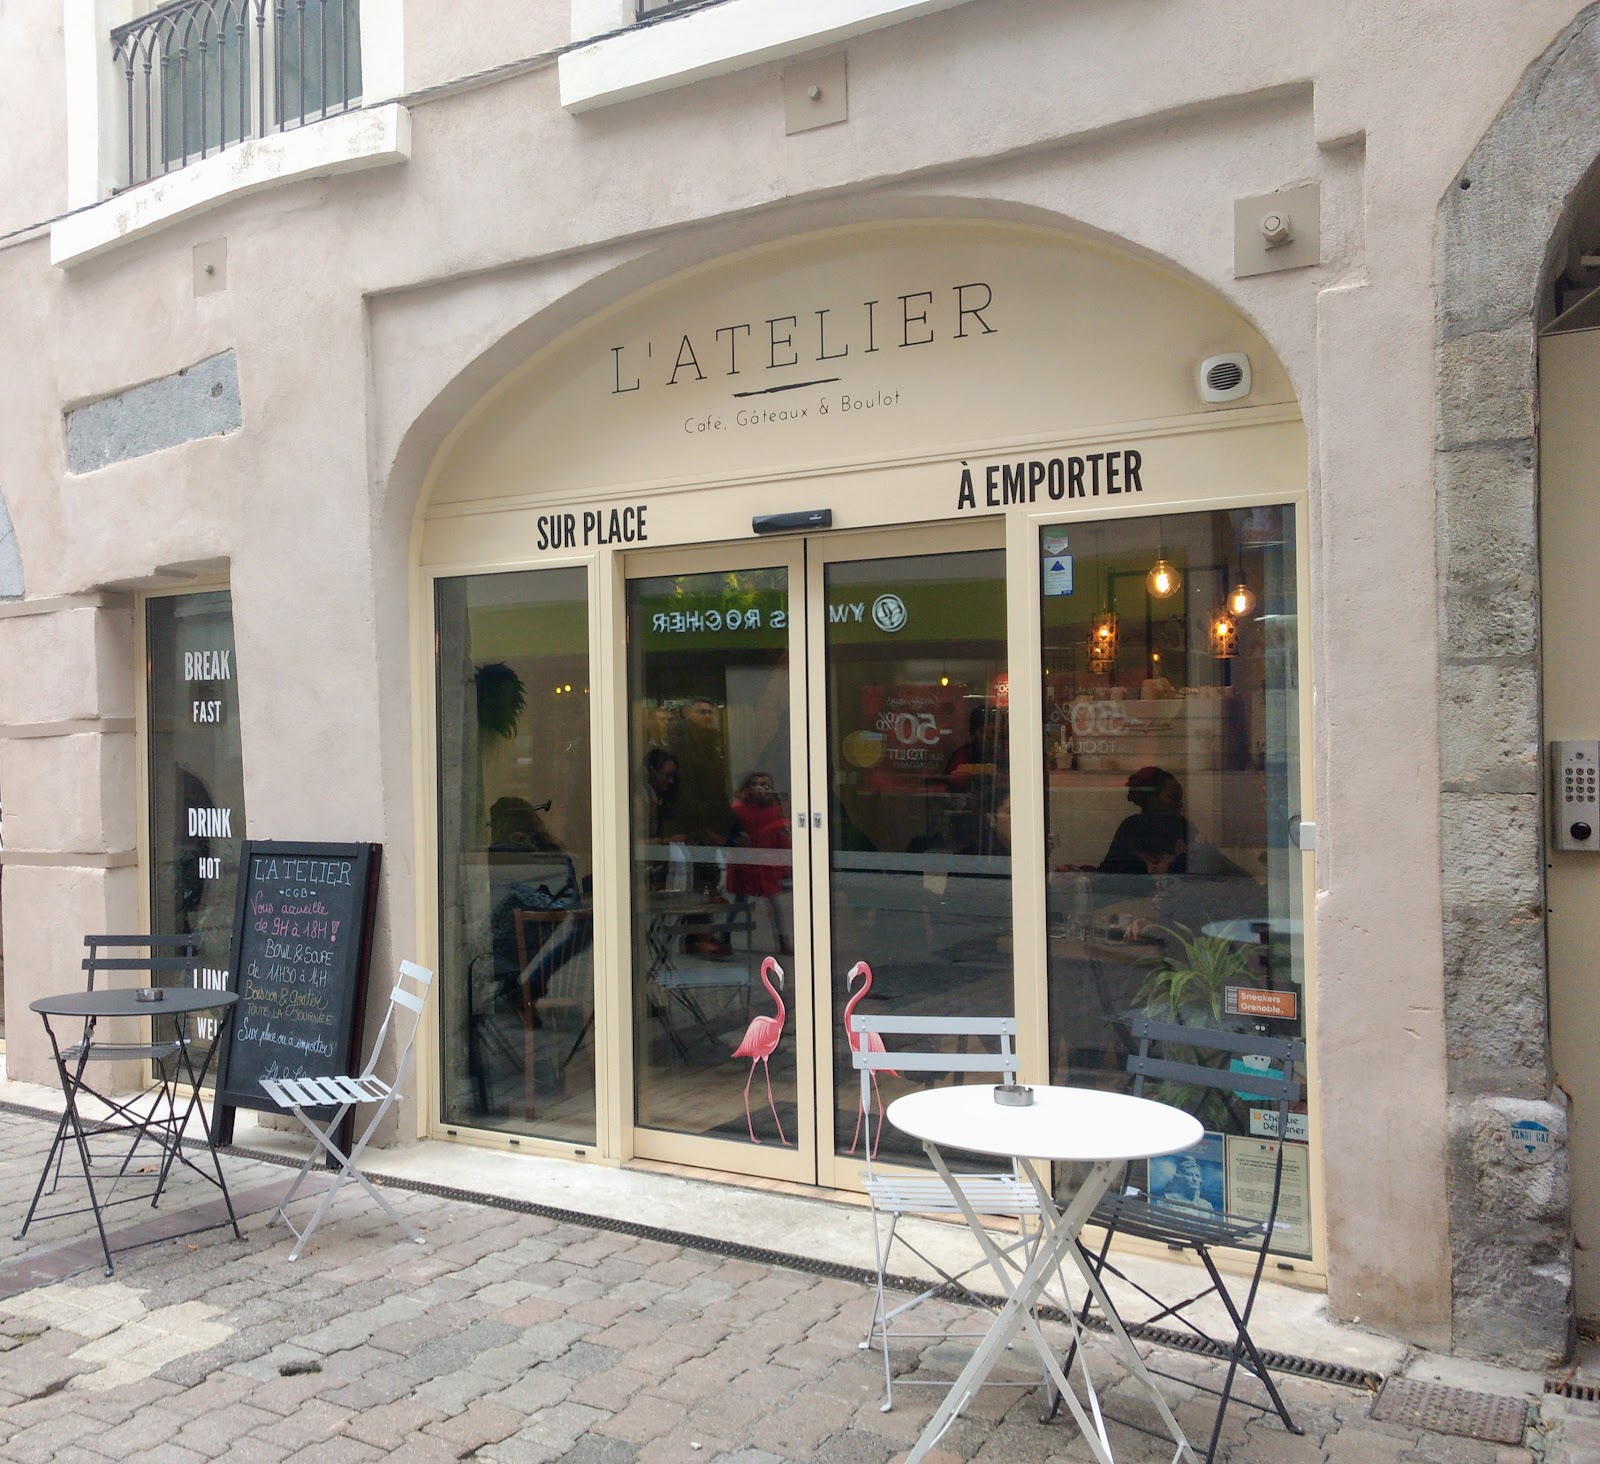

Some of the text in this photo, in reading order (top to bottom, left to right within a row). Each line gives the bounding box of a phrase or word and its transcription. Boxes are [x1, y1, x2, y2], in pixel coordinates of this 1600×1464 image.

[611, 282, 998, 394] L'ATELIER
[684, 390, 900, 433] Café, Gâteaux & Boulot
[957, 449, 1143, 510] À EMPORTER
[537, 505, 648, 550] SUR PLACE
[184, 650, 231, 681] BREAK
[193, 701, 222, 723] FAST
[188, 808, 232, 838] DRINK
[198, 857, 221, 880] HOT
[255, 859, 352, 886] L'ATELIER
[251, 891, 328, 916] Vous accueille
[254, 917, 268, 933] de
[271, 917, 290, 937] 9H
[291, 921, 301, 938] à
[193, 968, 230, 992] LUNC
[247, 960, 327, 988] de 11H30 à 14H
[1241, 992, 1281, 1003] Sneakers
[247, 1003, 269, 1017] TOUTE
[273, 1008, 282, 1020] LA
[197, 1017, 224, 1041] WEL
[1262, 1112, 1299, 1125] Chèue
[1263, 1122, 1305, 1135] Déjner
